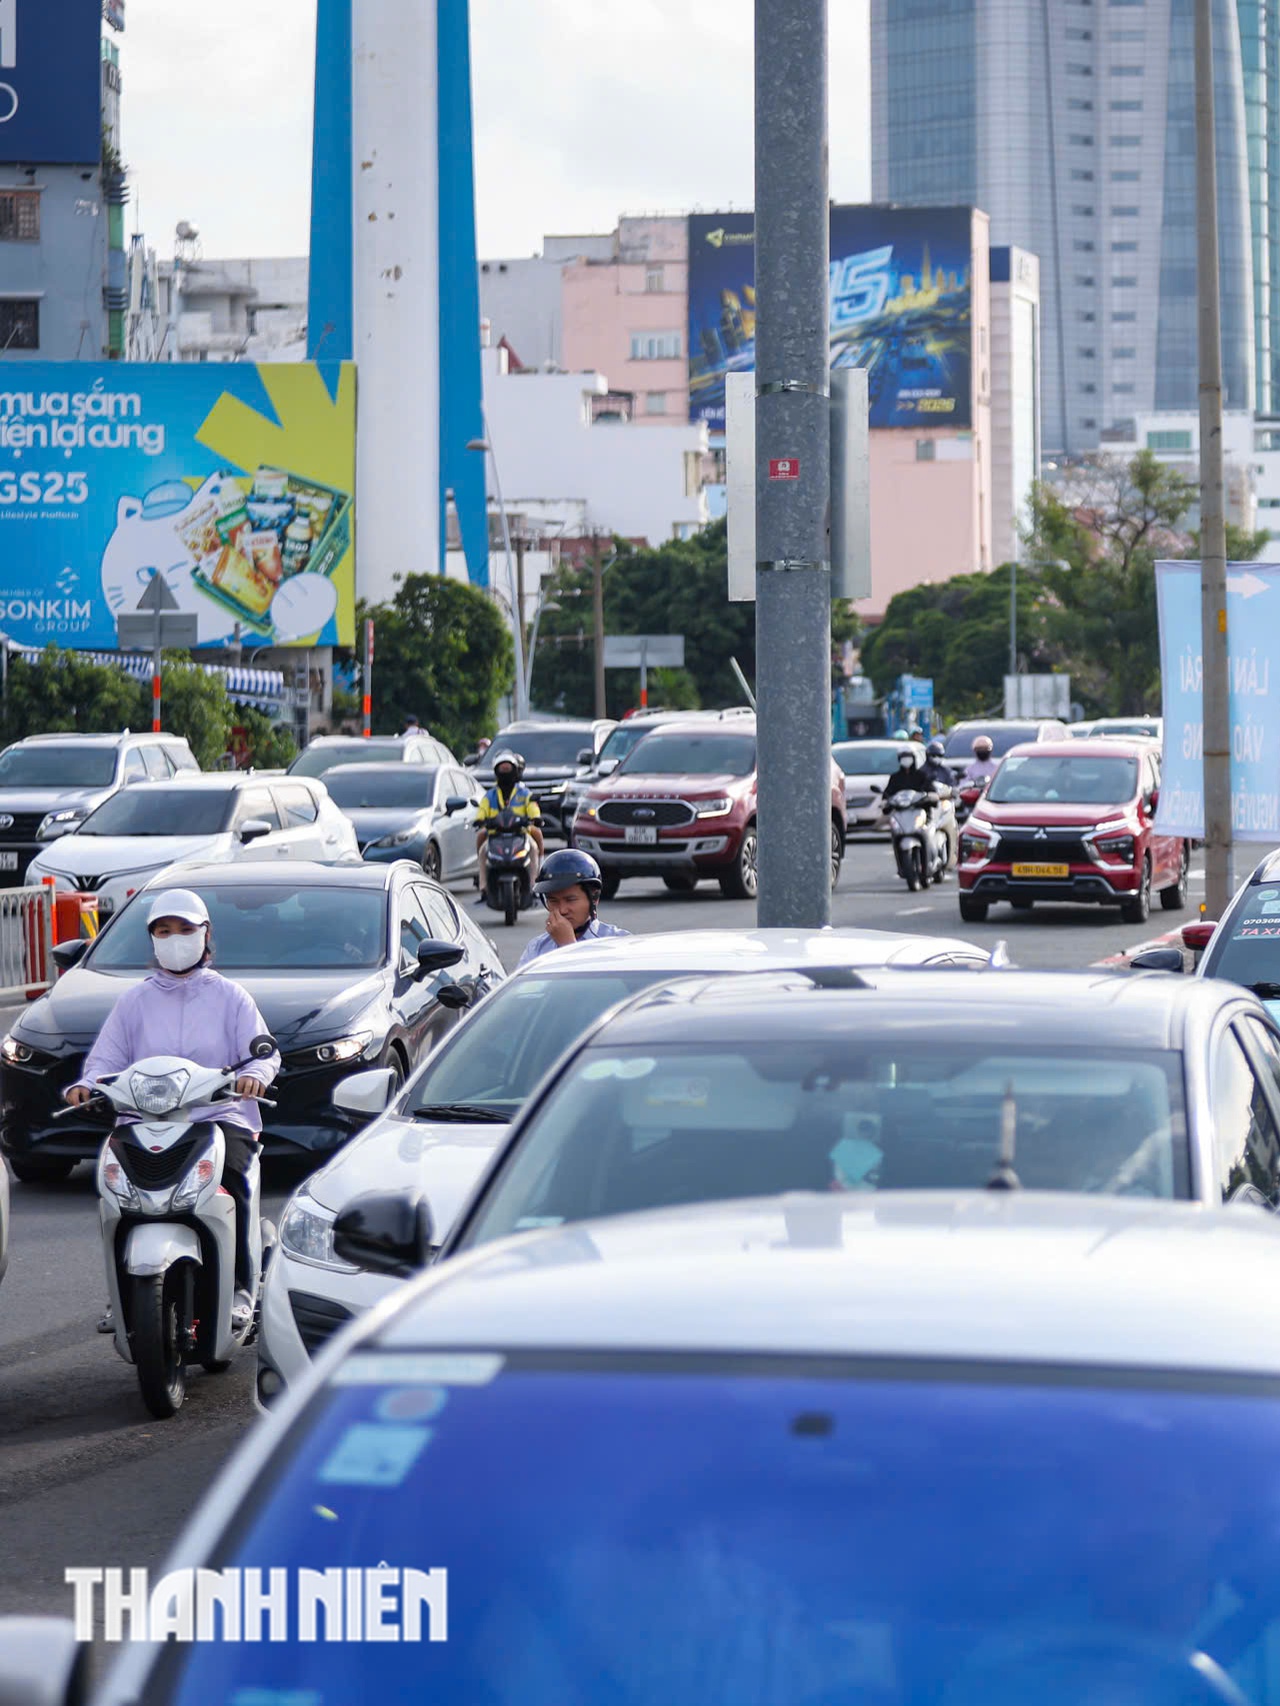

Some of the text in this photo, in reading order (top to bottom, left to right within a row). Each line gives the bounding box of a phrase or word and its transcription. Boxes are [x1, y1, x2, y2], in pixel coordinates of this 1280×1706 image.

[72, 377, 141, 417] sắm
[0, 415, 47, 458] iện
[0, 471, 88, 504] GS25
[35, 621, 90, 632] GROUP
